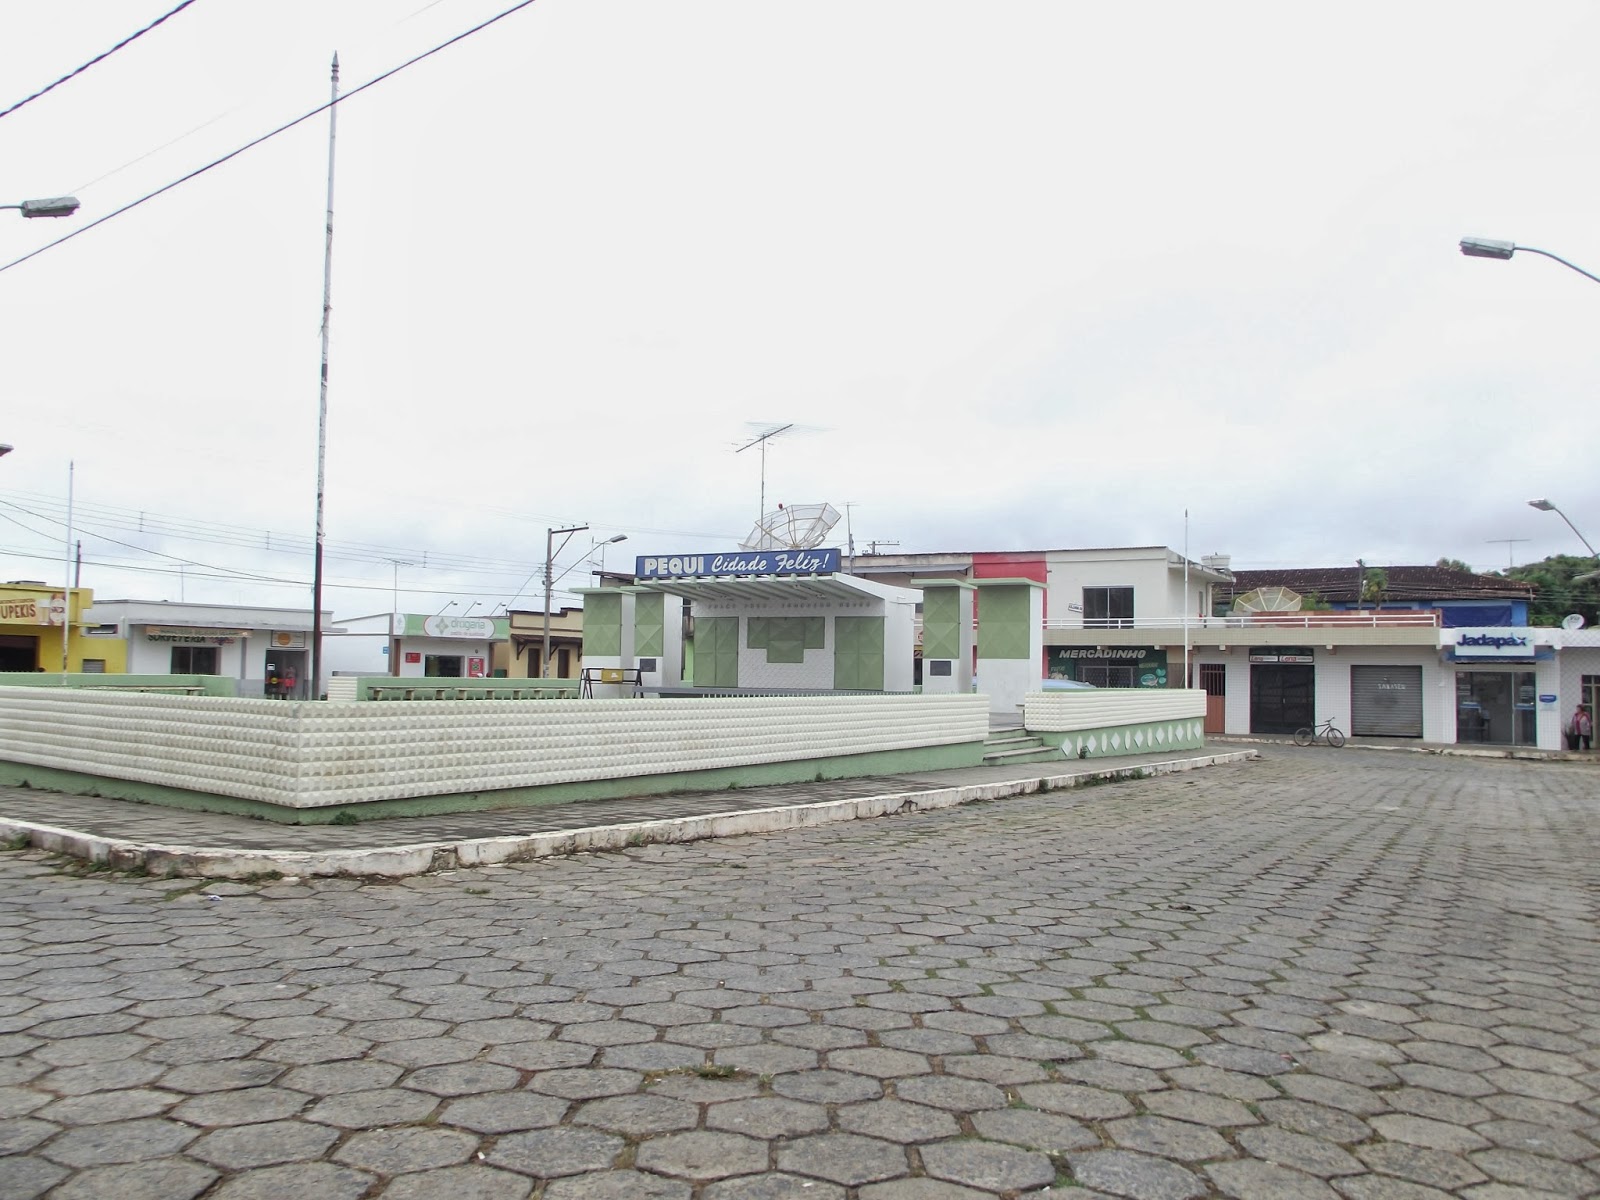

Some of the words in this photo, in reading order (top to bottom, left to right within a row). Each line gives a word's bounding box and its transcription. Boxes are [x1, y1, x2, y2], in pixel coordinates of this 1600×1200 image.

[644, 556, 704, 576] PEQUI
[711, 555, 767, 572] Cidade
[774, 552, 830, 571] Feliz!
[450, 617, 486, 630] drogaria
[1058, 649, 1147, 659] MERCADINHO
